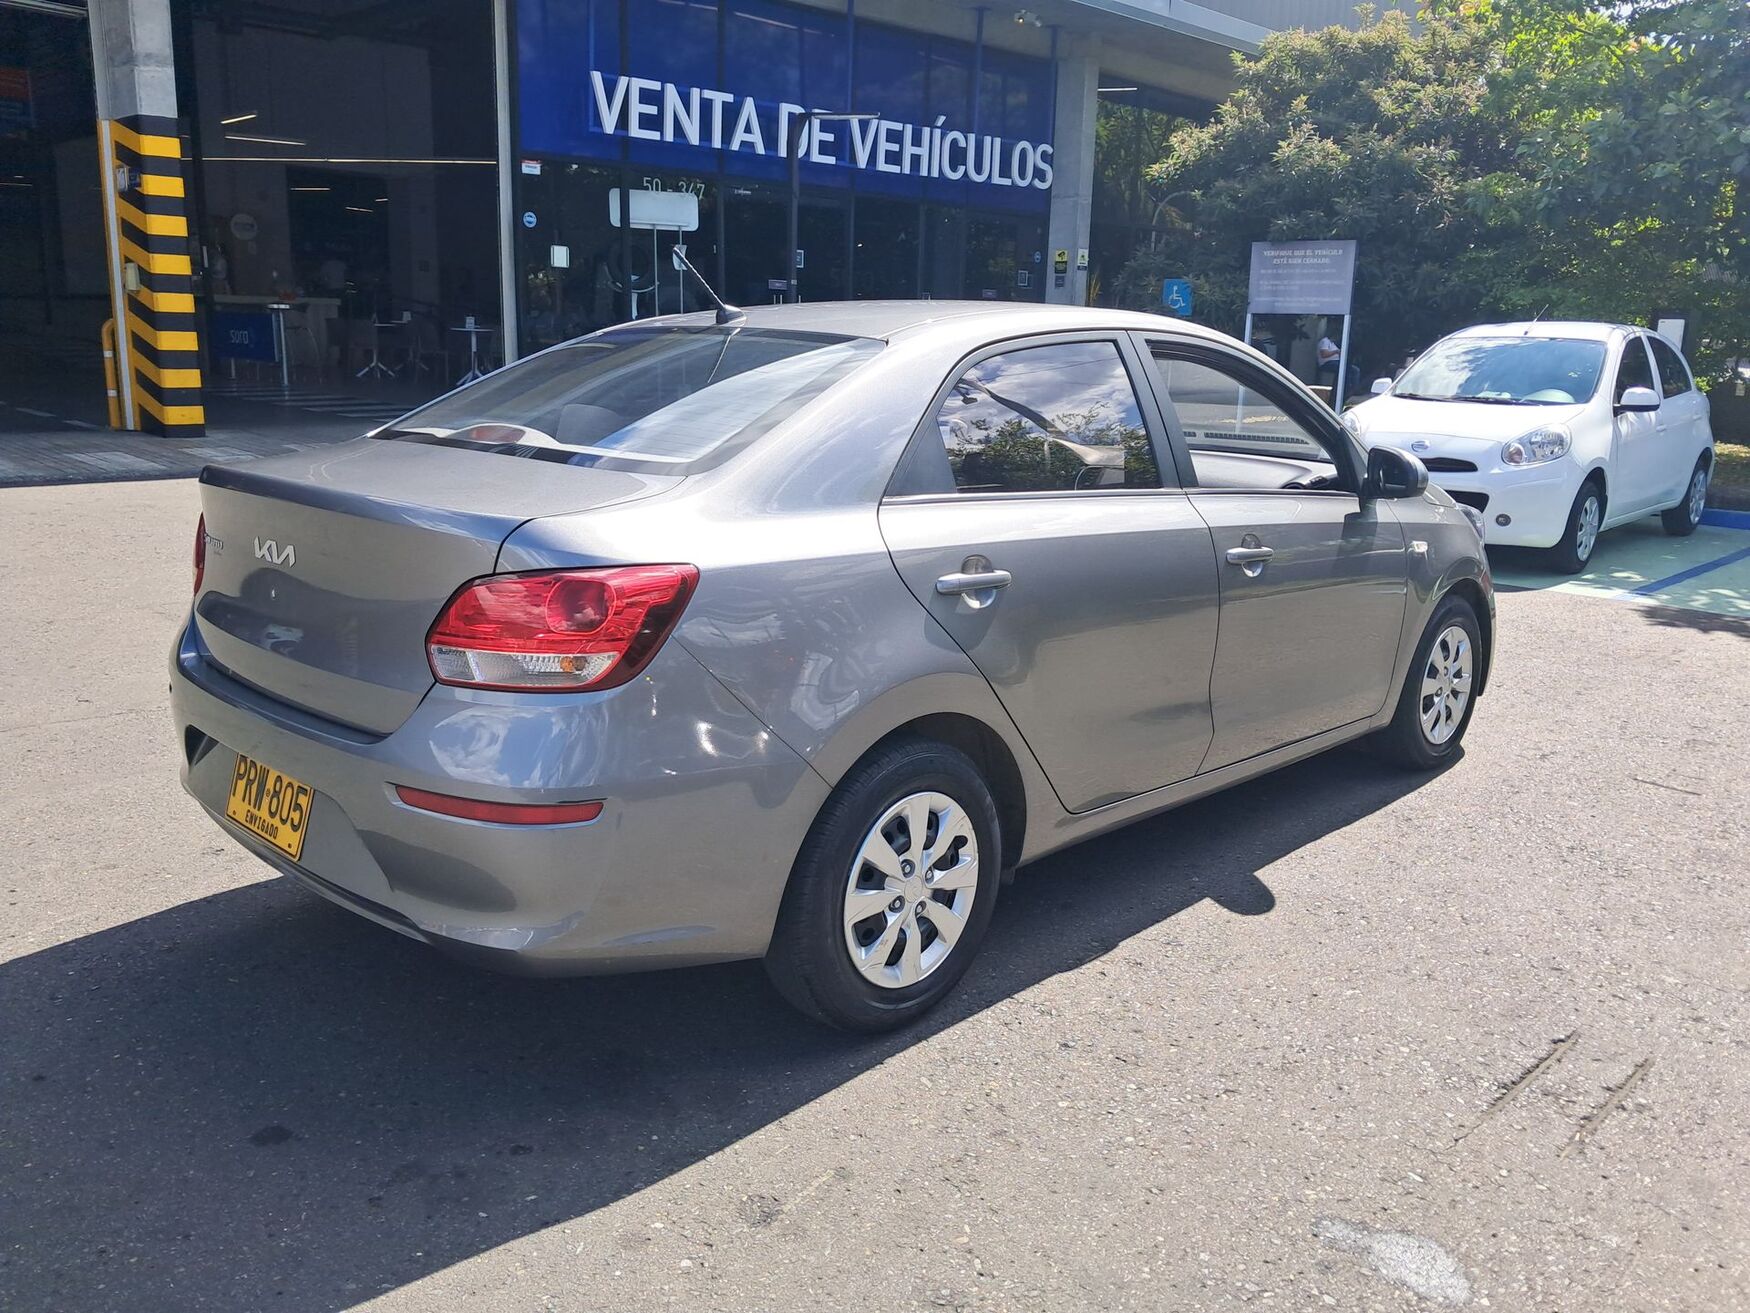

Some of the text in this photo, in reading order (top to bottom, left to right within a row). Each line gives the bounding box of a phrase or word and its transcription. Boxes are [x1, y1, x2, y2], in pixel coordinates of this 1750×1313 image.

[589, 70, 1054, 190] VENTA DE VEHÍCULOS
[643, 177, 661, 193] 50
[253, 536, 296, 568] KIA
[232, 754, 308, 833] PRW 805
[245, 809, 279, 840] ENVIGADO
